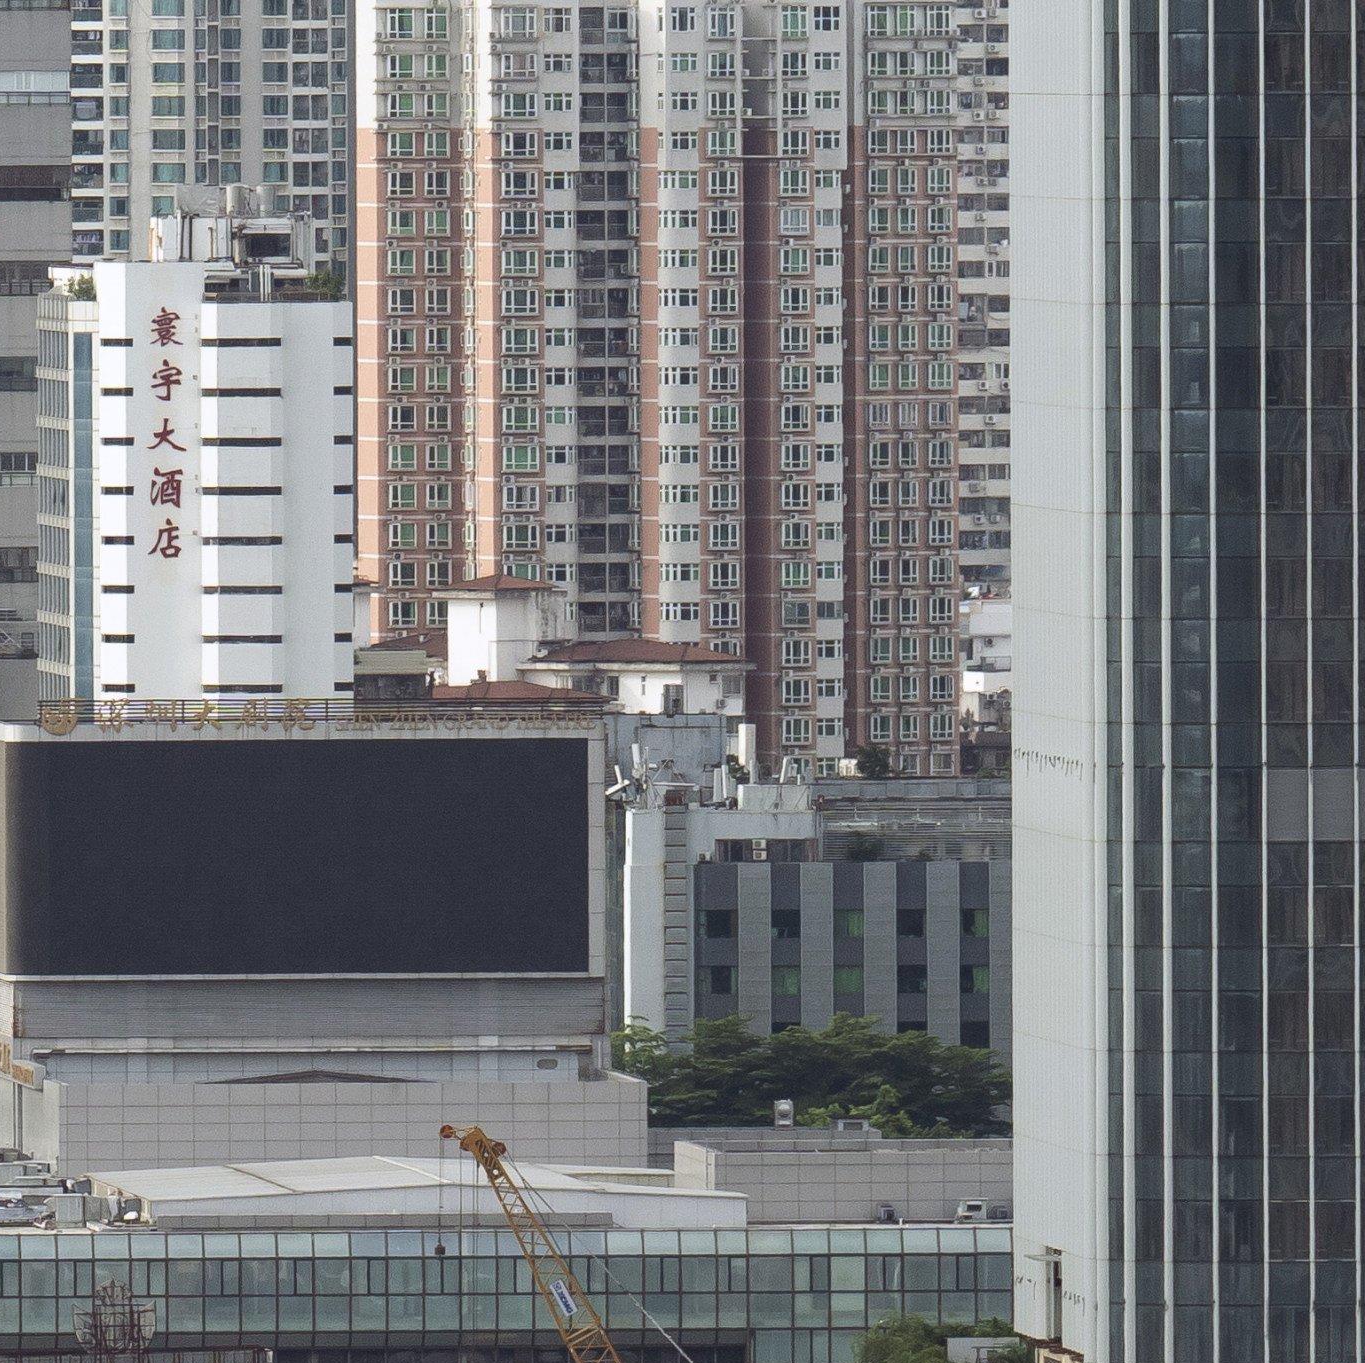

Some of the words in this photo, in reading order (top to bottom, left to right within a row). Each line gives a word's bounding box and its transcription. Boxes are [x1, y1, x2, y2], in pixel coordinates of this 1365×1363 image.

[147, 306, 187, 560] 寰宇大酒店
[443, 713, 509, 731] GRAND
[516, 713, 597, 731] THEATRE
